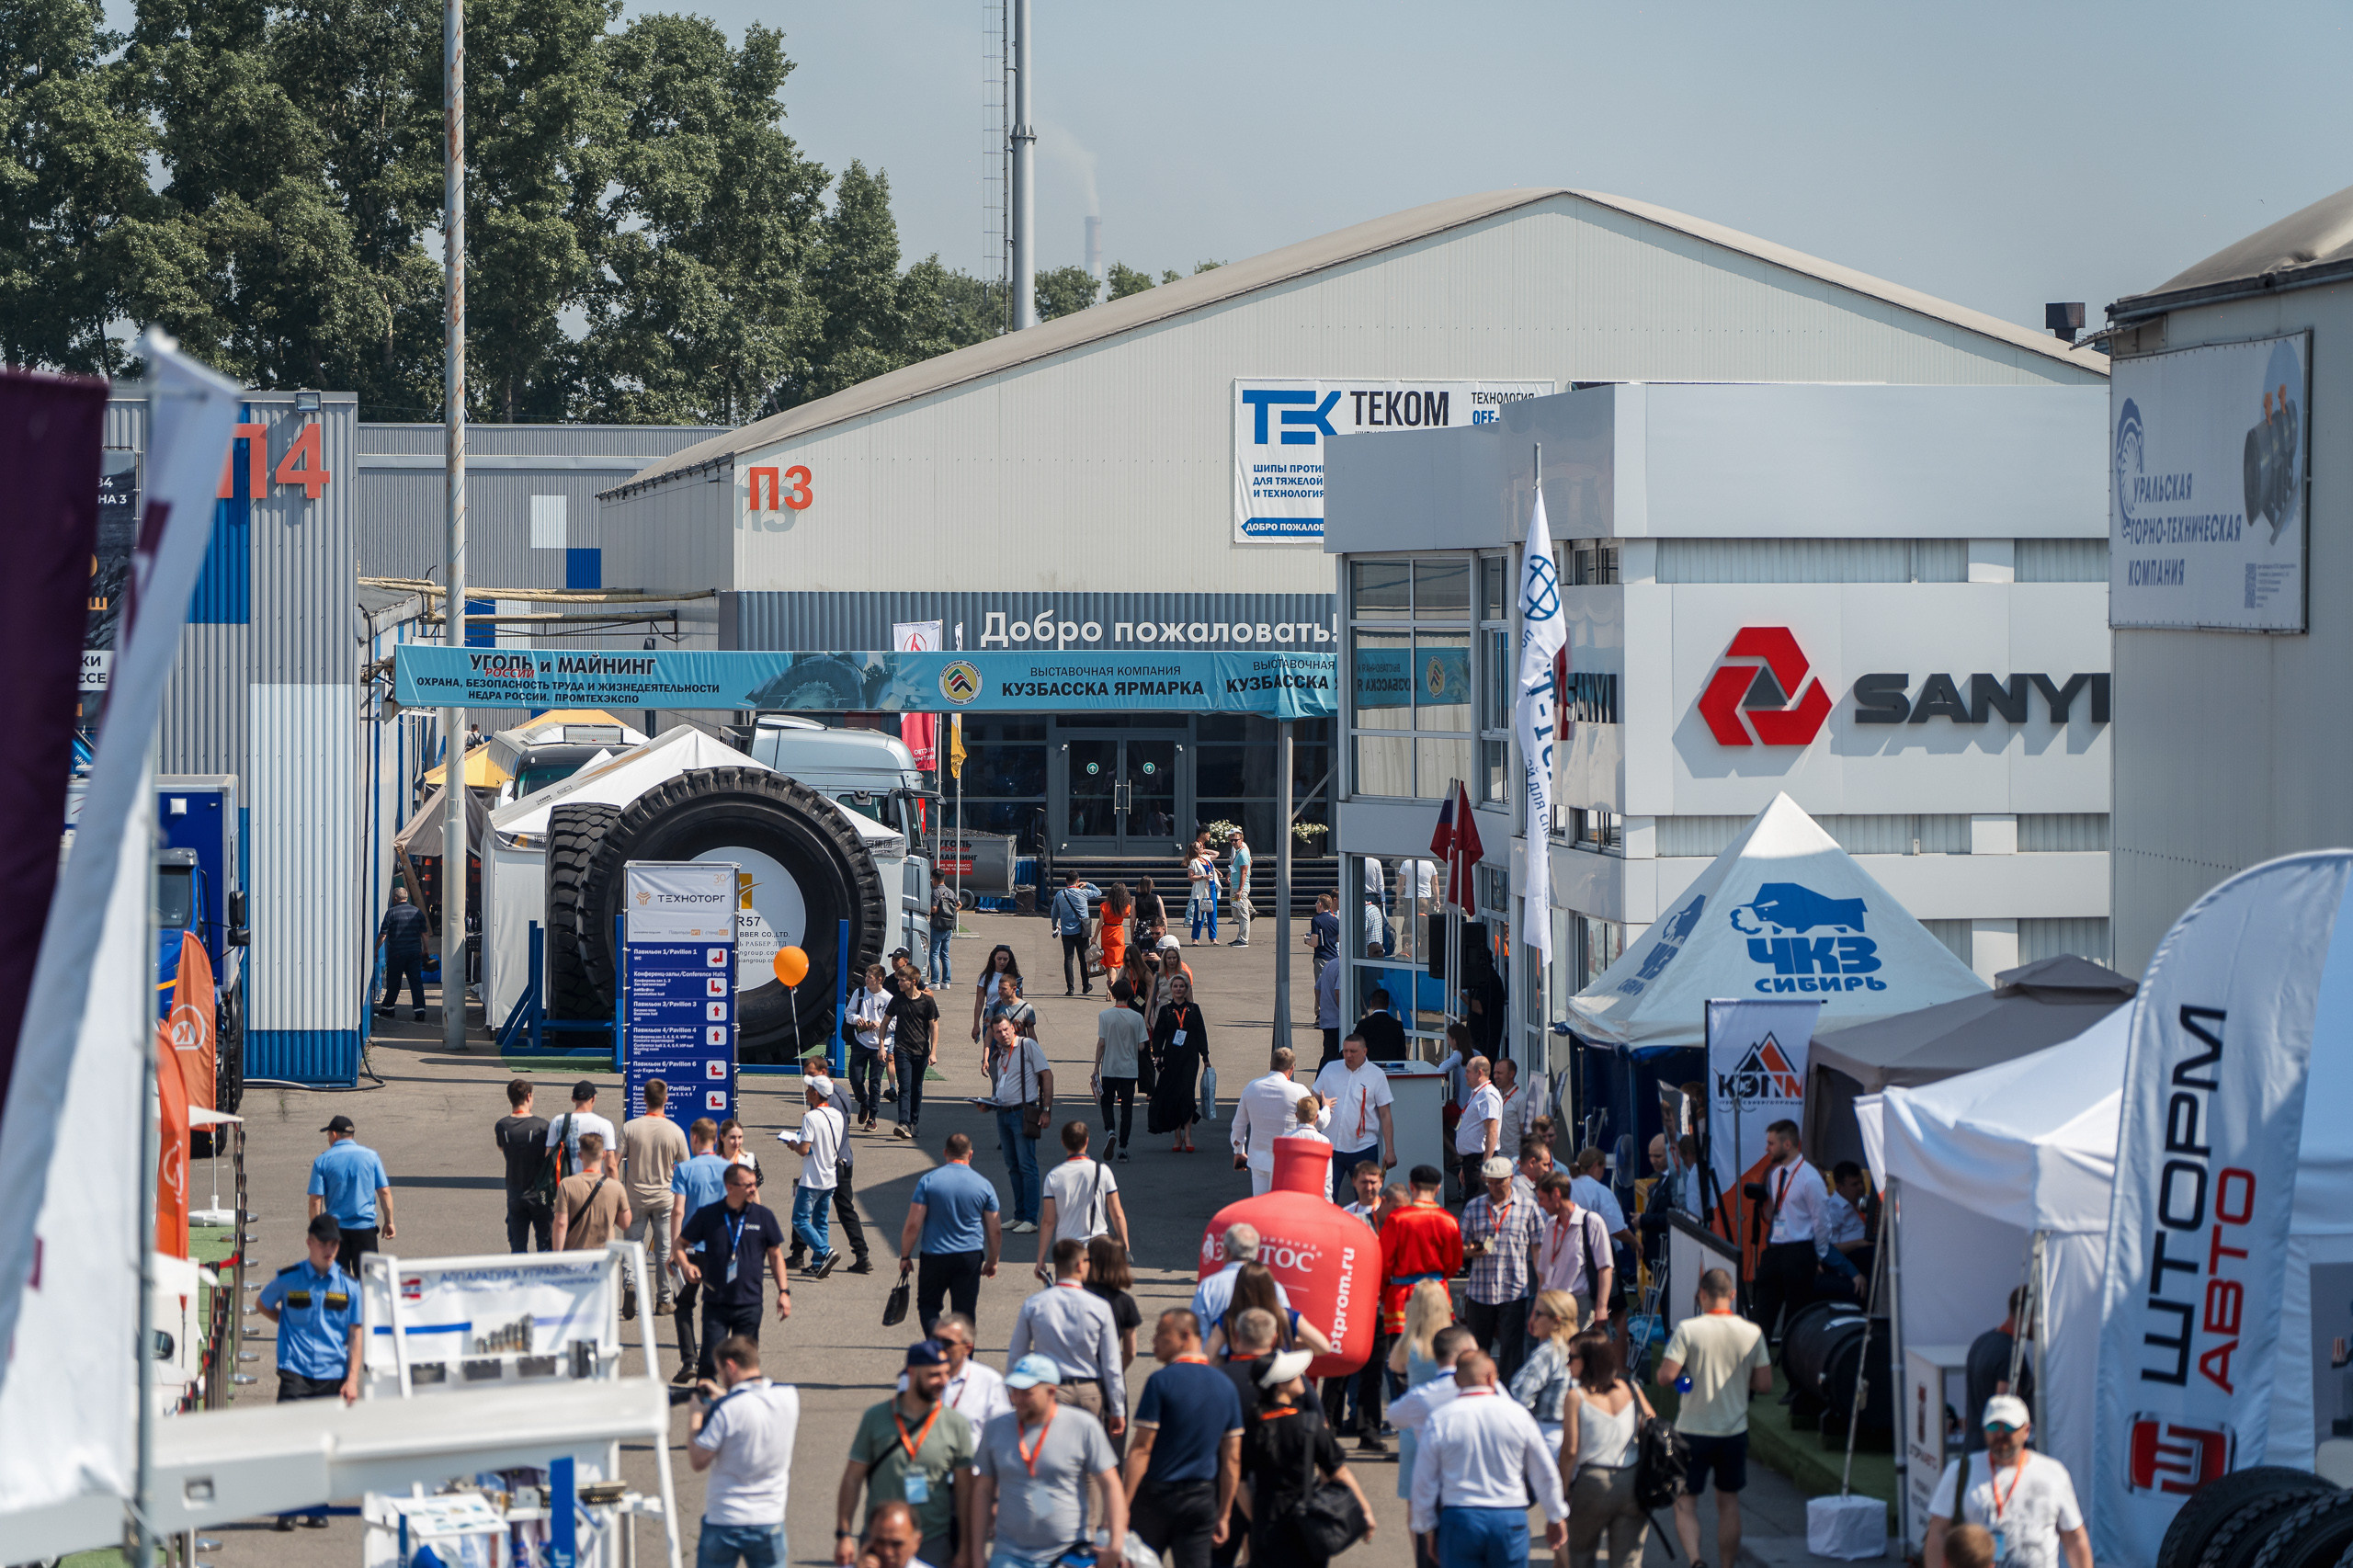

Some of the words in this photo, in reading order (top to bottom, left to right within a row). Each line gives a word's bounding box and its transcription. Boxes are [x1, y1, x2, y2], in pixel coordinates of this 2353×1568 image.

[1350, 391, 1449, 426] ТЕКОМ
[1253, 464, 1287, 473] ШИПЫ
[1290, 464, 1324, 473] ПРОТИ
[1253, 476, 1273, 486] ДЛЯ
[1275, 474, 1324, 486] ТЯЖЕЛОЙ
[2133, 472, 2192, 504] УРАЛЬСКАЯ
[1253, 489, 1260, 497] И
[1245, 522, 1279, 532] ДОБРО
[2130, 514, 2242, 545] ГОРНО-ТЕХНИЧЕСКАЯ
[2128, 559, 2185, 586] КОМПАНИЯ
[981, 609, 1103, 650] Добро
[1114, 613, 1337, 643] пожаловать!
[470, 653, 533, 671] УГОЛЬ
[540, 661, 551, 673] и
[557, 653, 656, 675] МАЙНИНГ
[484, 667, 535, 678] РОССИИ
[1030, 666, 1114, 676] ВЫСТАВОЧНАЯ
[1117, 666, 1181, 676] КОМПАНИЯ
[1253, 659, 1335, 671] ВЫСТАВОЧНАЯ
[416, 677, 463, 688] ОХРАНА,
[466, 678, 550, 690] БЕЗОПАСНОСТЬ
[552, 682, 585, 692] ТРУДА
[597, 683, 720, 694] ЖИЗНЕДЕЯТЕЛЬНОСТИ
[1114, 681, 1204, 696] ЯРМАРКА
[468, 690, 502, 701] НЕДРА
[505, 691, 550, 702] РОССИИ.
[554, 693, 639, 704] ПРОМТЕХЭКСПО
[657, 894, 725, 903] ТЕХНОТОРГ
[1746, 936, 1882, 975] ЧКЗ
[1755, 976, 1887, 993] СИБИРЬ
[2141, 1005, 2227, 1387] ШТОРМ
[2198, 1166, 2256, 1396] АВТО
[1329, 1247, 1355, 1355] ptprom.ru
